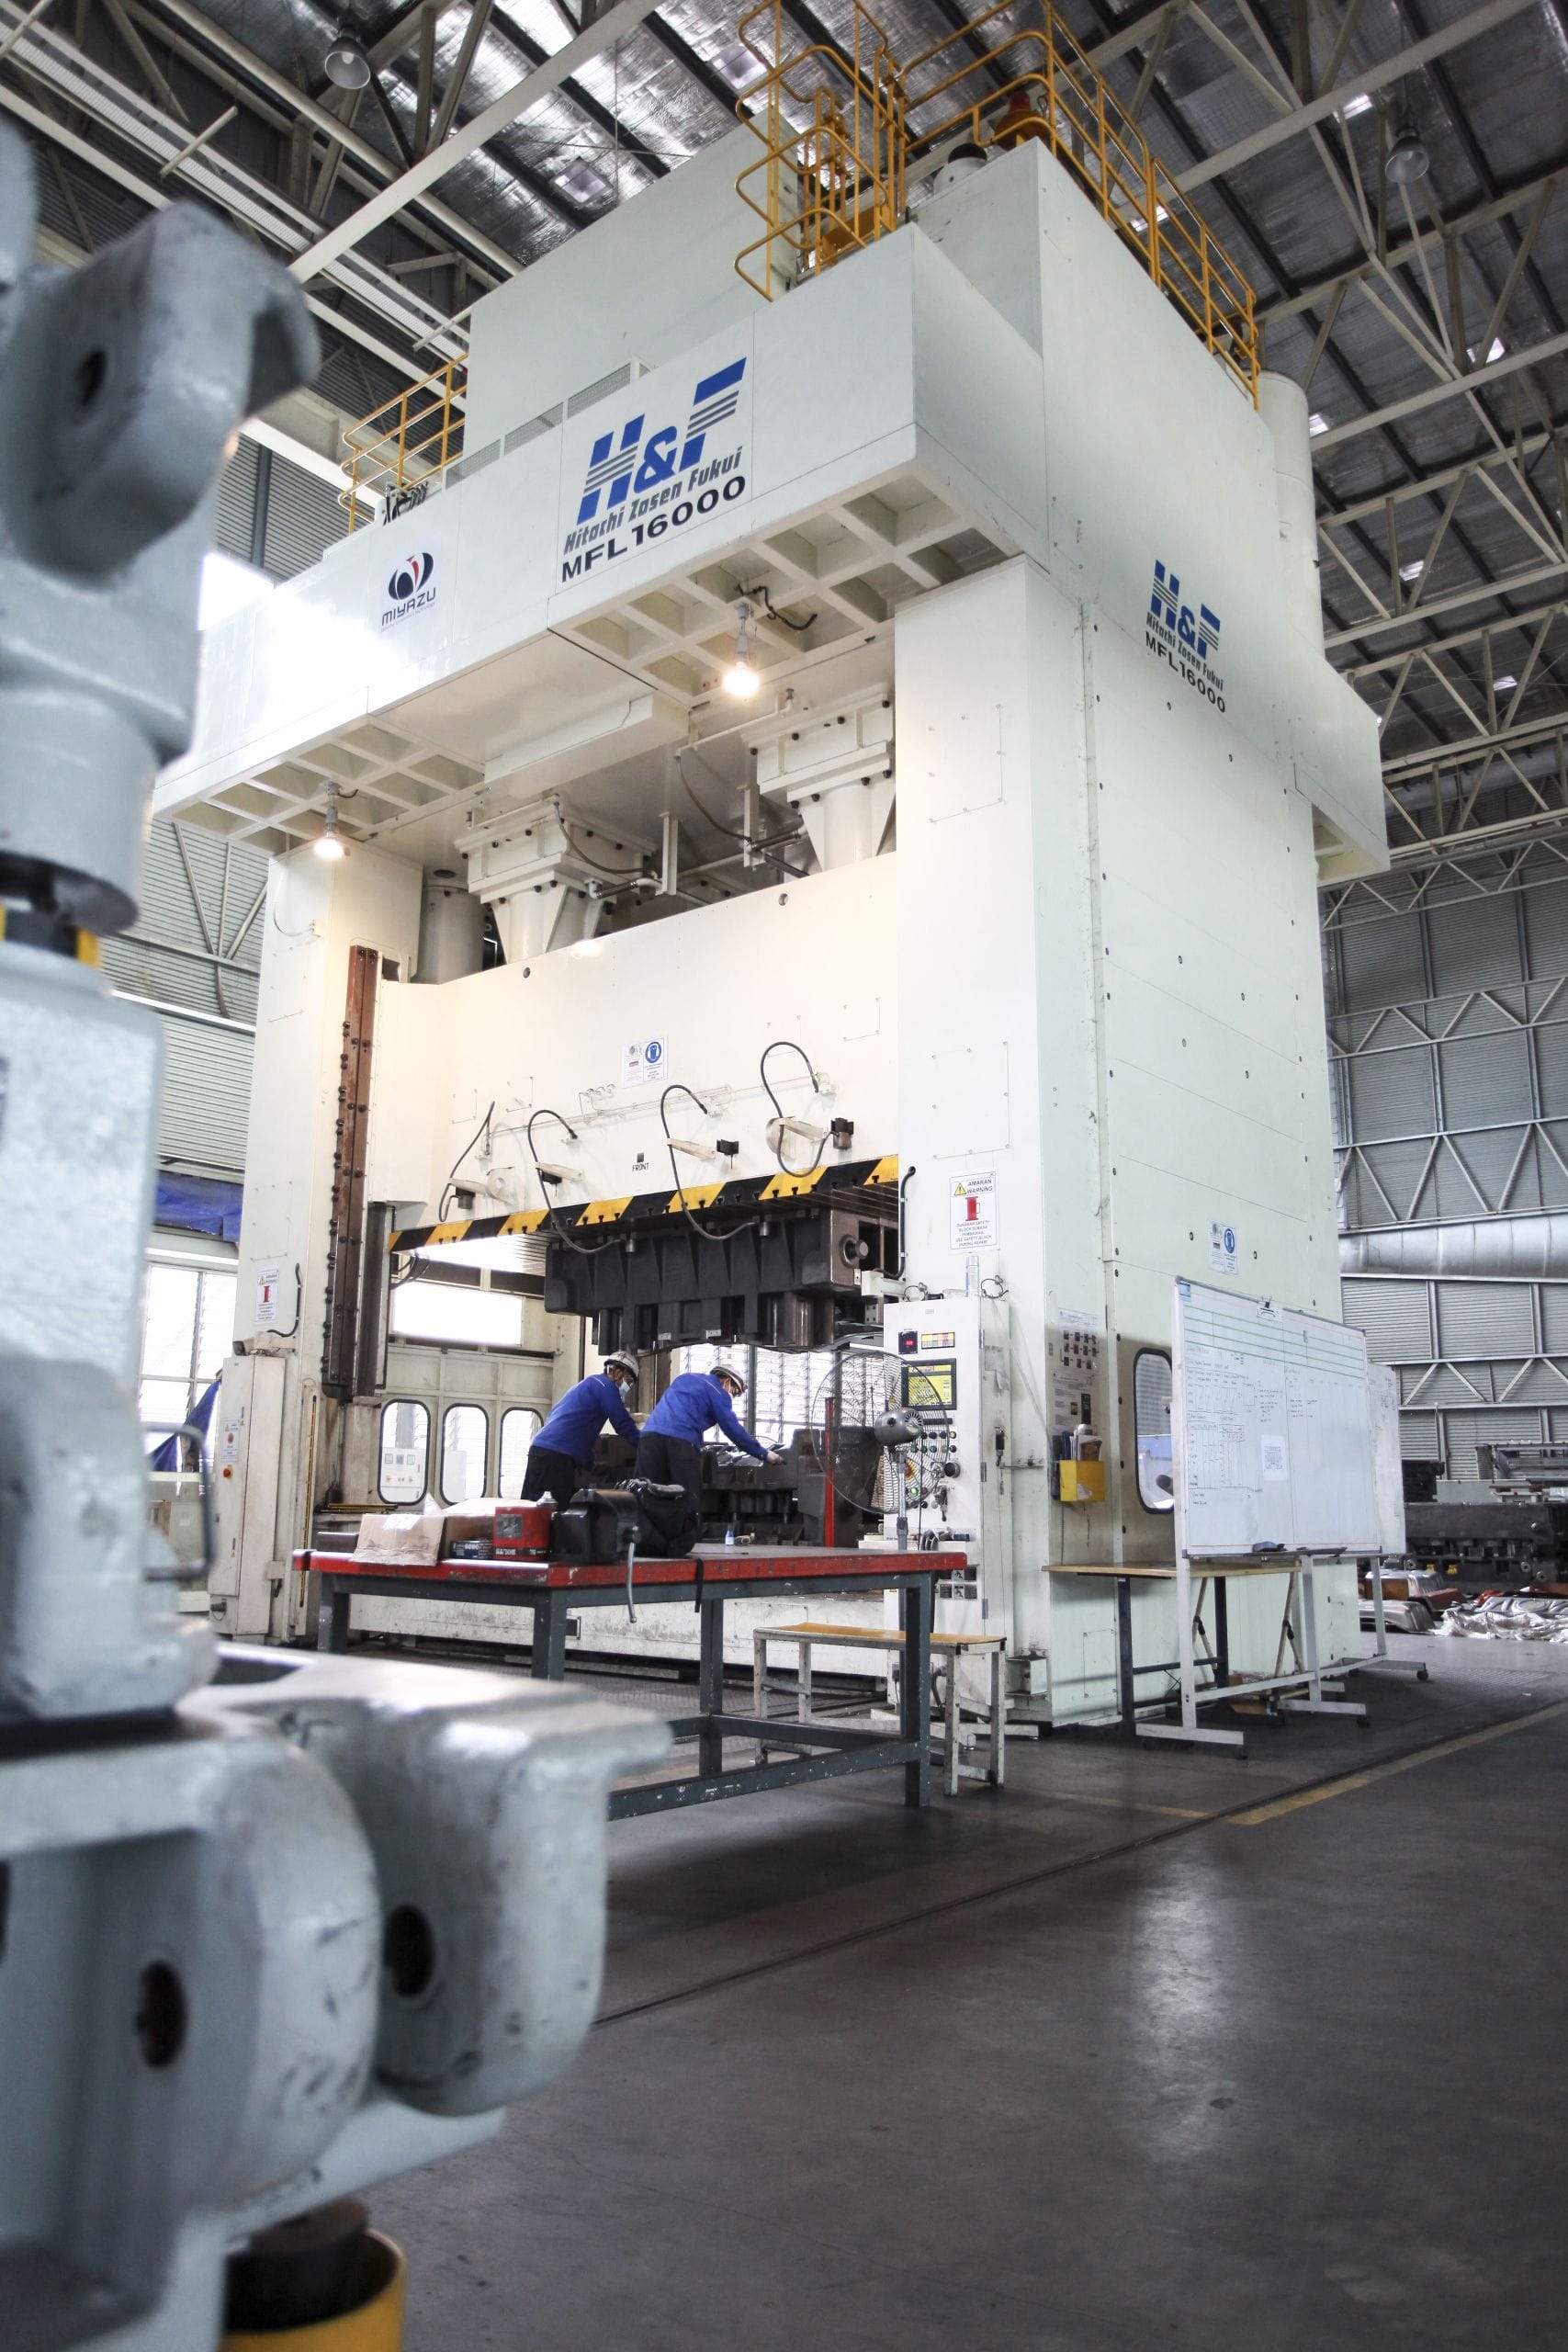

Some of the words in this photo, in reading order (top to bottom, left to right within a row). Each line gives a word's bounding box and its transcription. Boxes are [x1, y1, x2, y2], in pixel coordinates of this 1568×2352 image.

[577, 356, 747, 526] H&F
[563, 507, 626, 556] Hitachi
[628, 481, 683, 523] Zosen
[687, 446, 743, 493] Fukui
[381, 587, 436, 627] MIYAZU
[1146, 611, 1177, 648] Hitachi
[1178, 639, 1201, 671] Zosen
[1202, 662, 1224, 692] Fukui
[1150, 559, 1221, 661] H&F
[632, 1163, 649, 1171] FRONT
